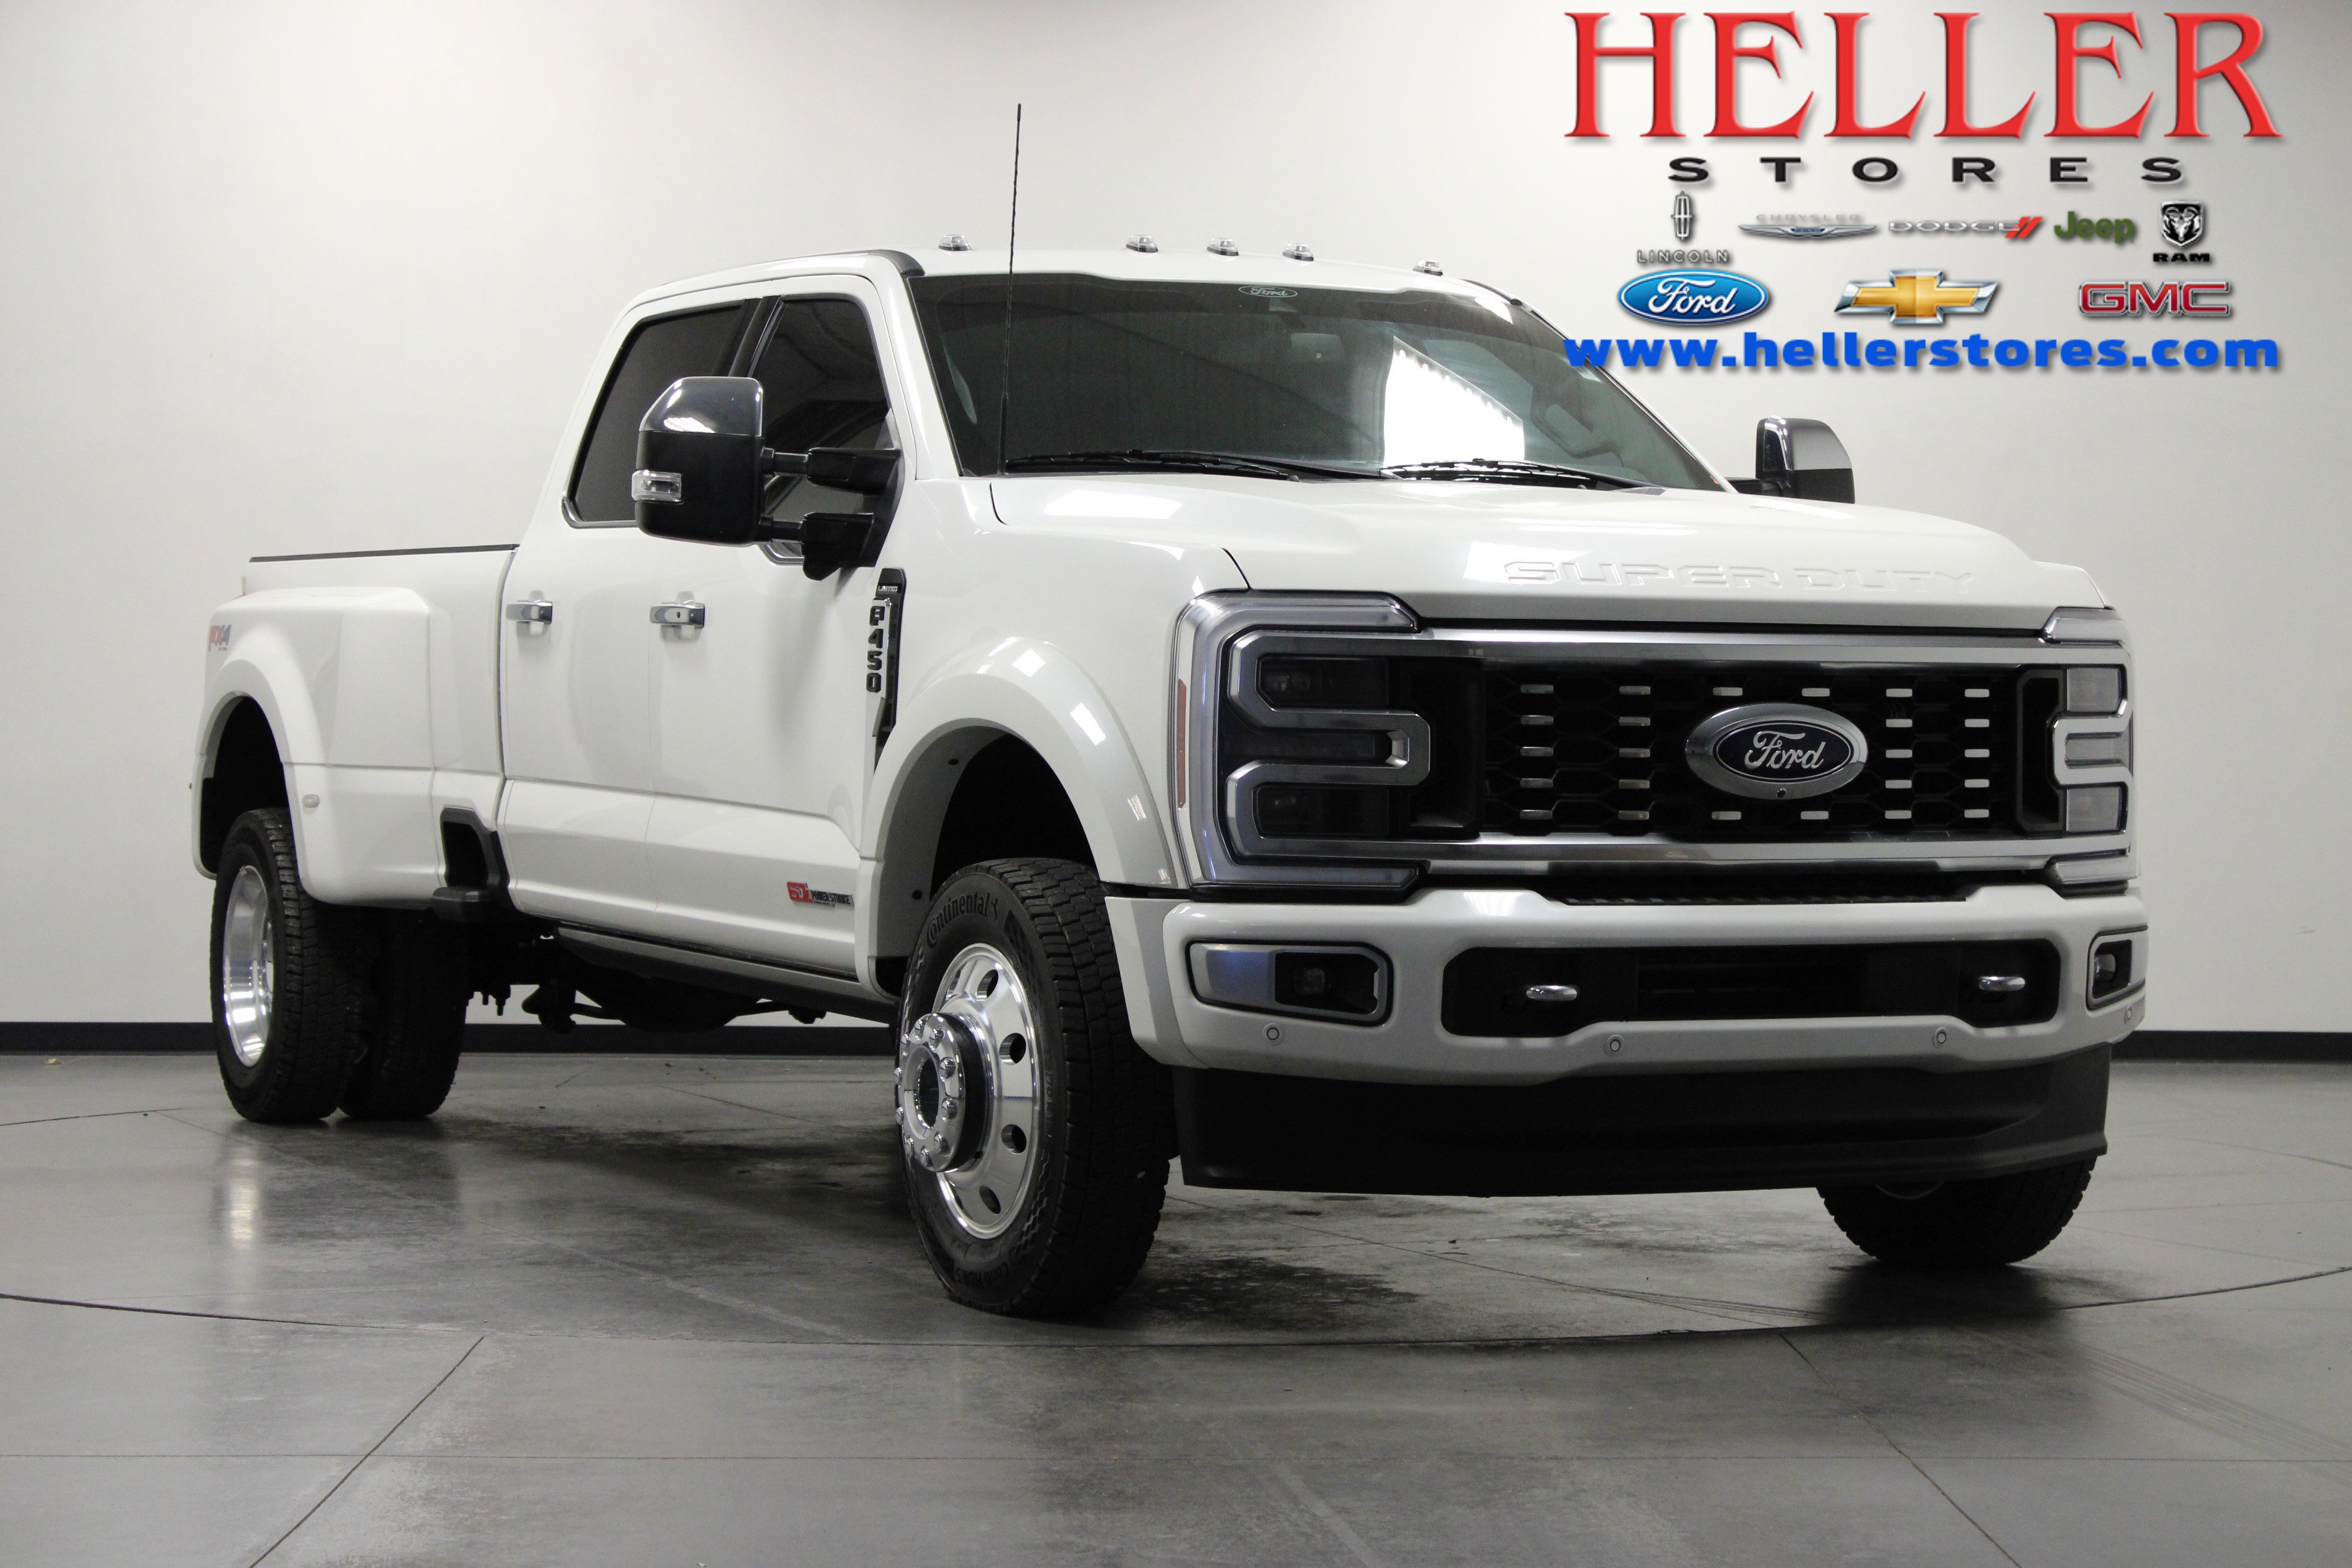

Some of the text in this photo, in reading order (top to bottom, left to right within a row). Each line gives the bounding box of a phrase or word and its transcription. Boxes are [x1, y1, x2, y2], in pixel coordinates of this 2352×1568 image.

[1250, 286, 1288, 296] Ford
[1504, 561, 1974, 593] SUPER DUTY
[1744, 730, 1827, 770] Ford
[926, 891, 991, 949] Continental
